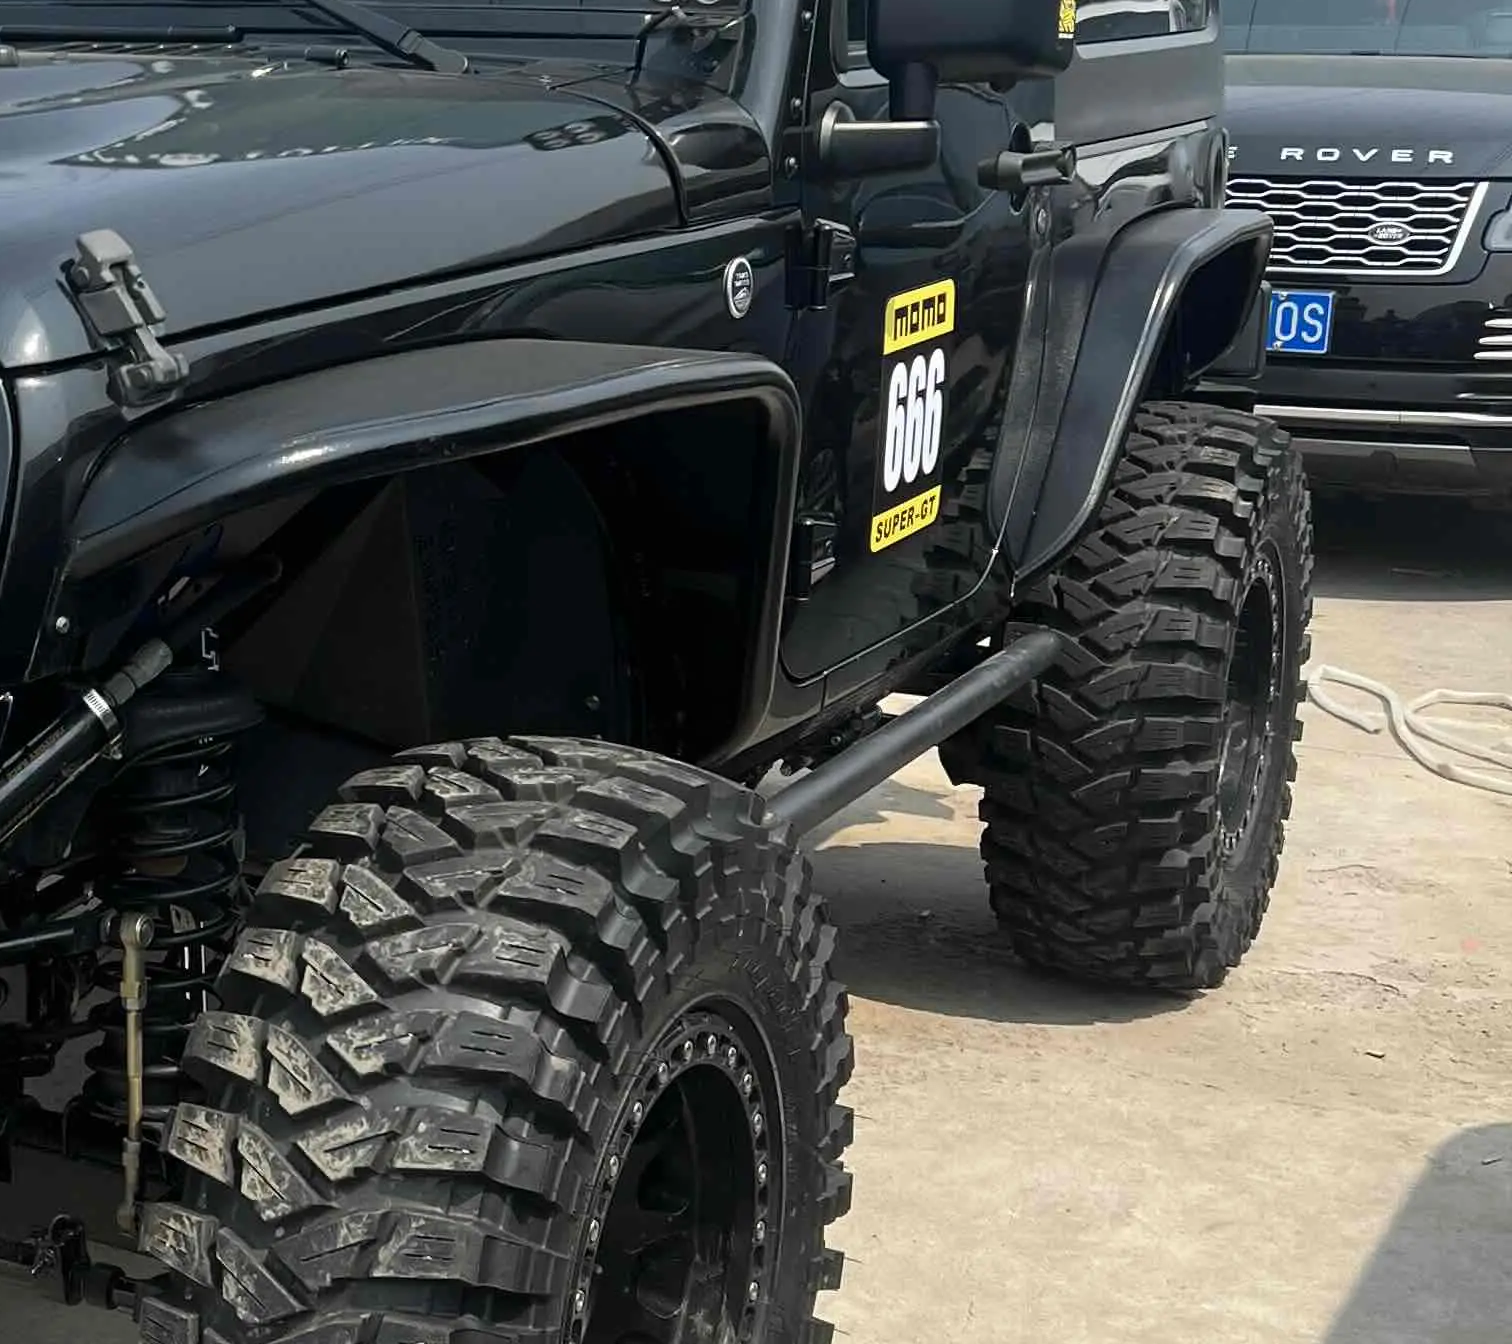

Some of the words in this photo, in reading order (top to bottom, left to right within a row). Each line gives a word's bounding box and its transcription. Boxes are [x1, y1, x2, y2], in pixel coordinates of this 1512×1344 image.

[1280, 147, 1455, 165] ROVER
[882, 347, 946, 493] 666
[875, 495, 936, 544] SUPER-GT
